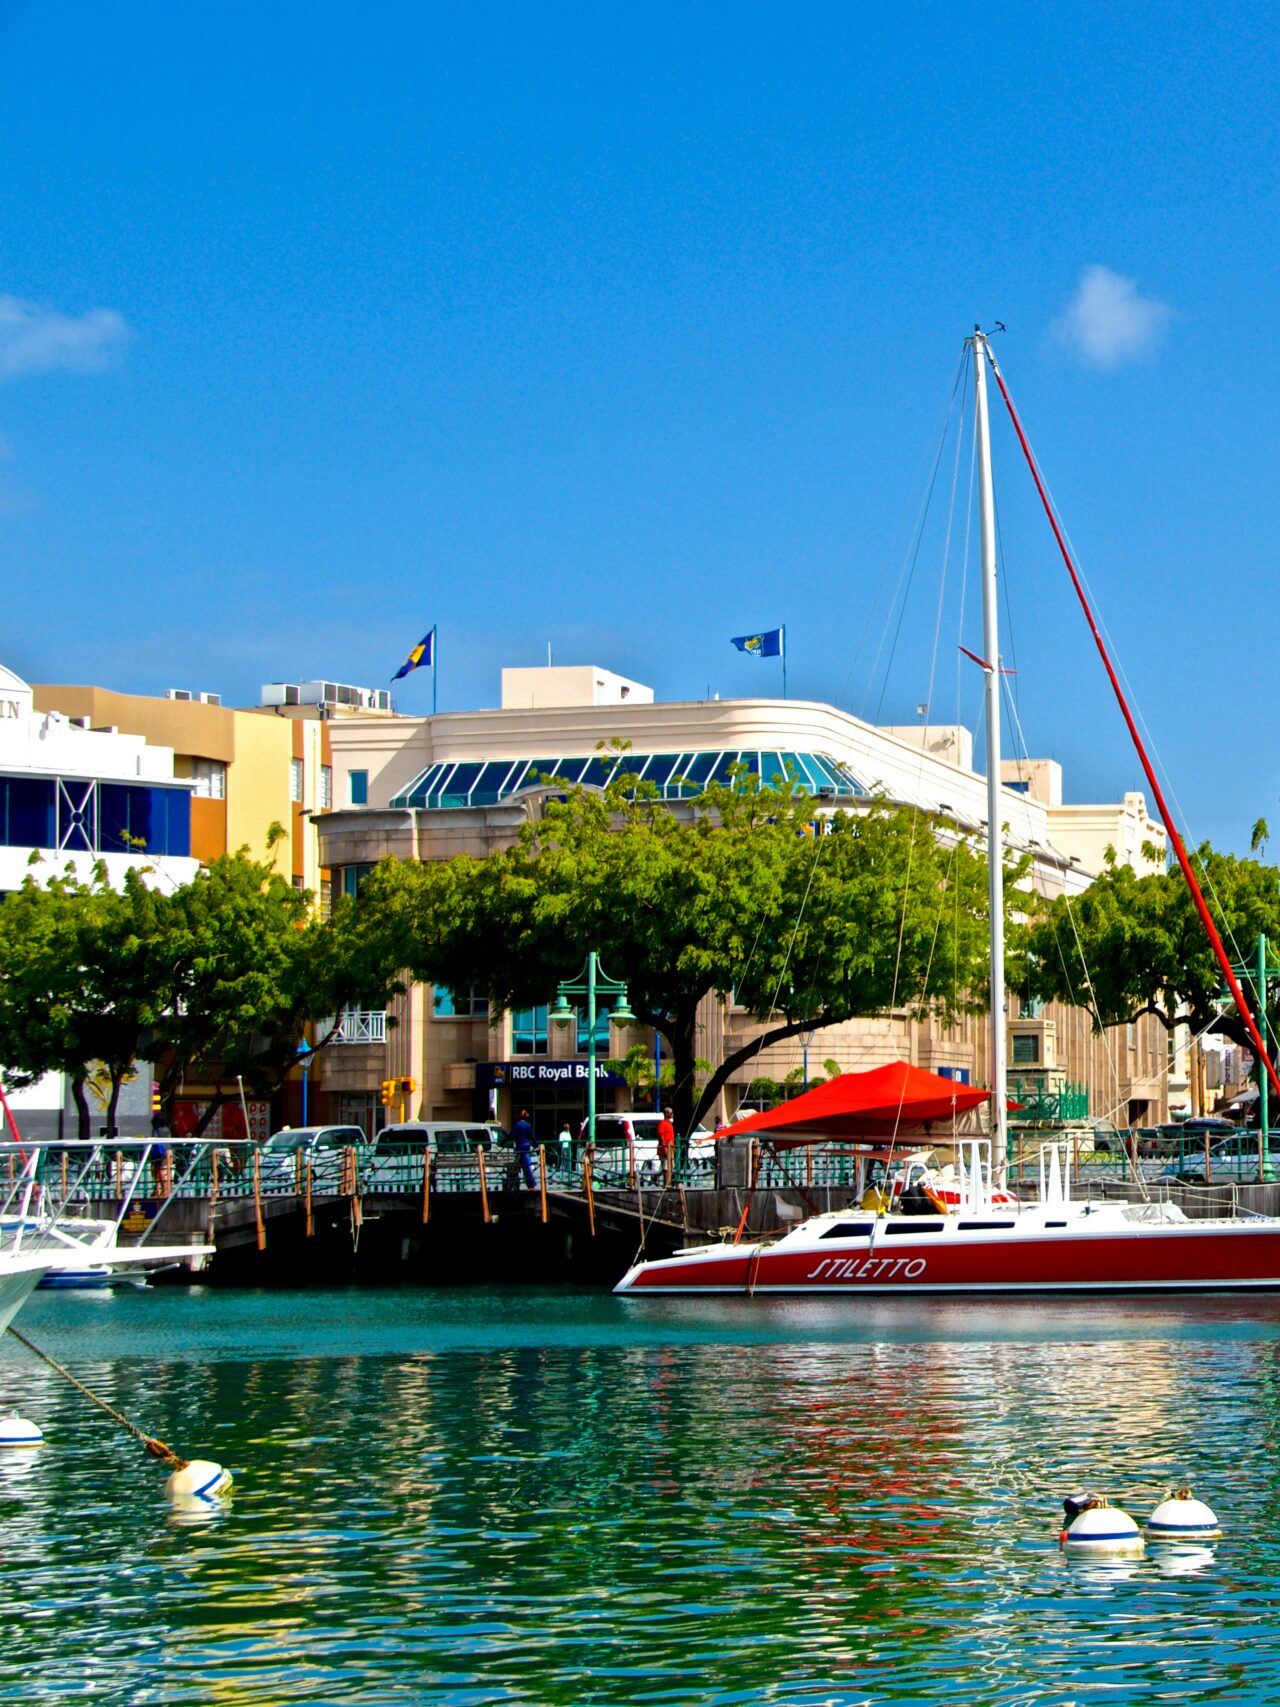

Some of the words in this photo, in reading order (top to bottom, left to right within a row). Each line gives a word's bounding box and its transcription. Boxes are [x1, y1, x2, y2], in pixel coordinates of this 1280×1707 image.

[512, 1066, 536, 1079] RBC
[538, 1064, 573, 1082] Royal
[807, 1258, 927, 1278] STILETTO
